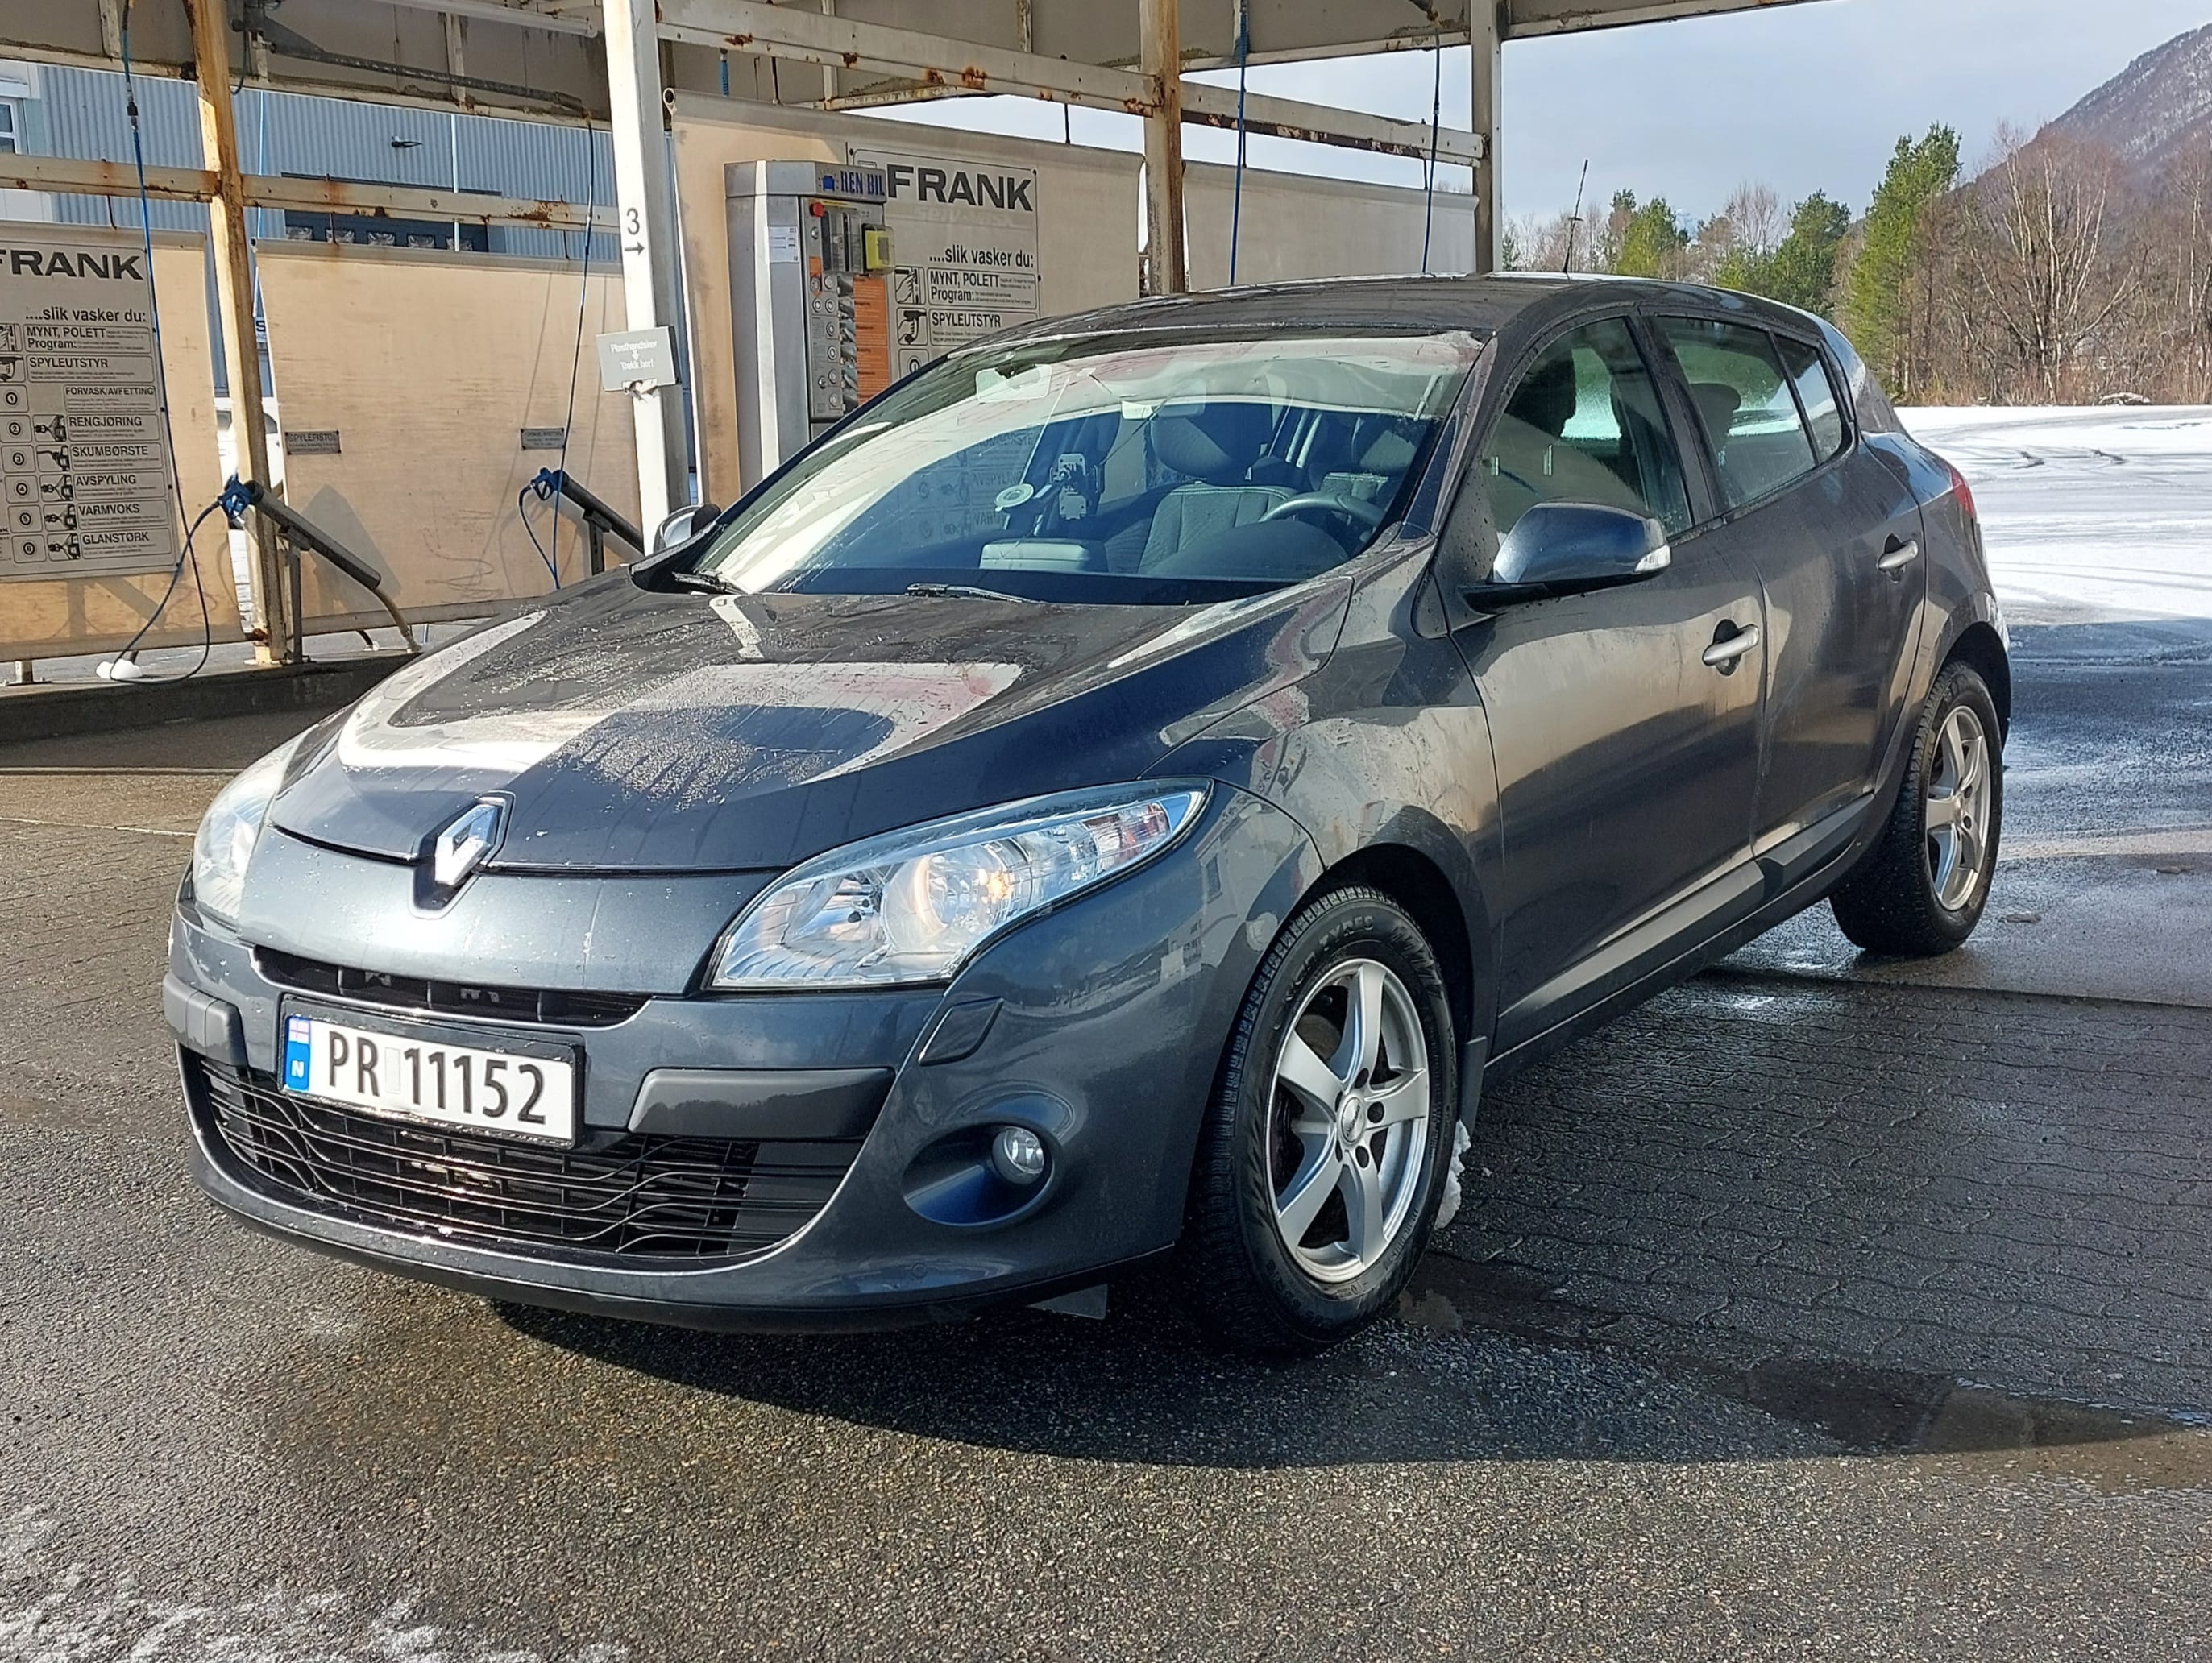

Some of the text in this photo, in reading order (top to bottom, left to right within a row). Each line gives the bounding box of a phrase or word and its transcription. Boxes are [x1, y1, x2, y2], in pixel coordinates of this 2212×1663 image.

[867, 173, 885, 197] BIL
[886, 164, 1033, 212] FRANK
[627, 207, 640, 235] 3
[0, 249, 143, 280] RANK
[971, 247, 1012, 267] vasker
[1015, 250, 1034, 268] du:
[930, 271, 961, 288] MYNT,
[963, 272, 1000, 288] POLETT
[931, 287, 974, 304] Program:
[73, 308, 120, 321] vasker
[124, 309, 147, 322] du:
[932, 312, 1002, 328] SPYLEUTSTYR
[27, 326, 60, 338] MYNT,
[64, 327, 106, 338] POLETT
[28, 338, 77, 350] Program:
[30, 357, 109, 369] SPYLEUTSTYR
[69, 416, 143, 428] RENGJØRING
[72, 446, 149, 458] SKUMBØRSTE
[76, 474, 137, 487] AVSPYLING
[78, 504, 140, 516] VARMVOKS
[82, 532, 150, 545] GLANSTØRK
[291, 1060, 305, 1078] N
[329, 1031, 546, 1126] PR 11152
